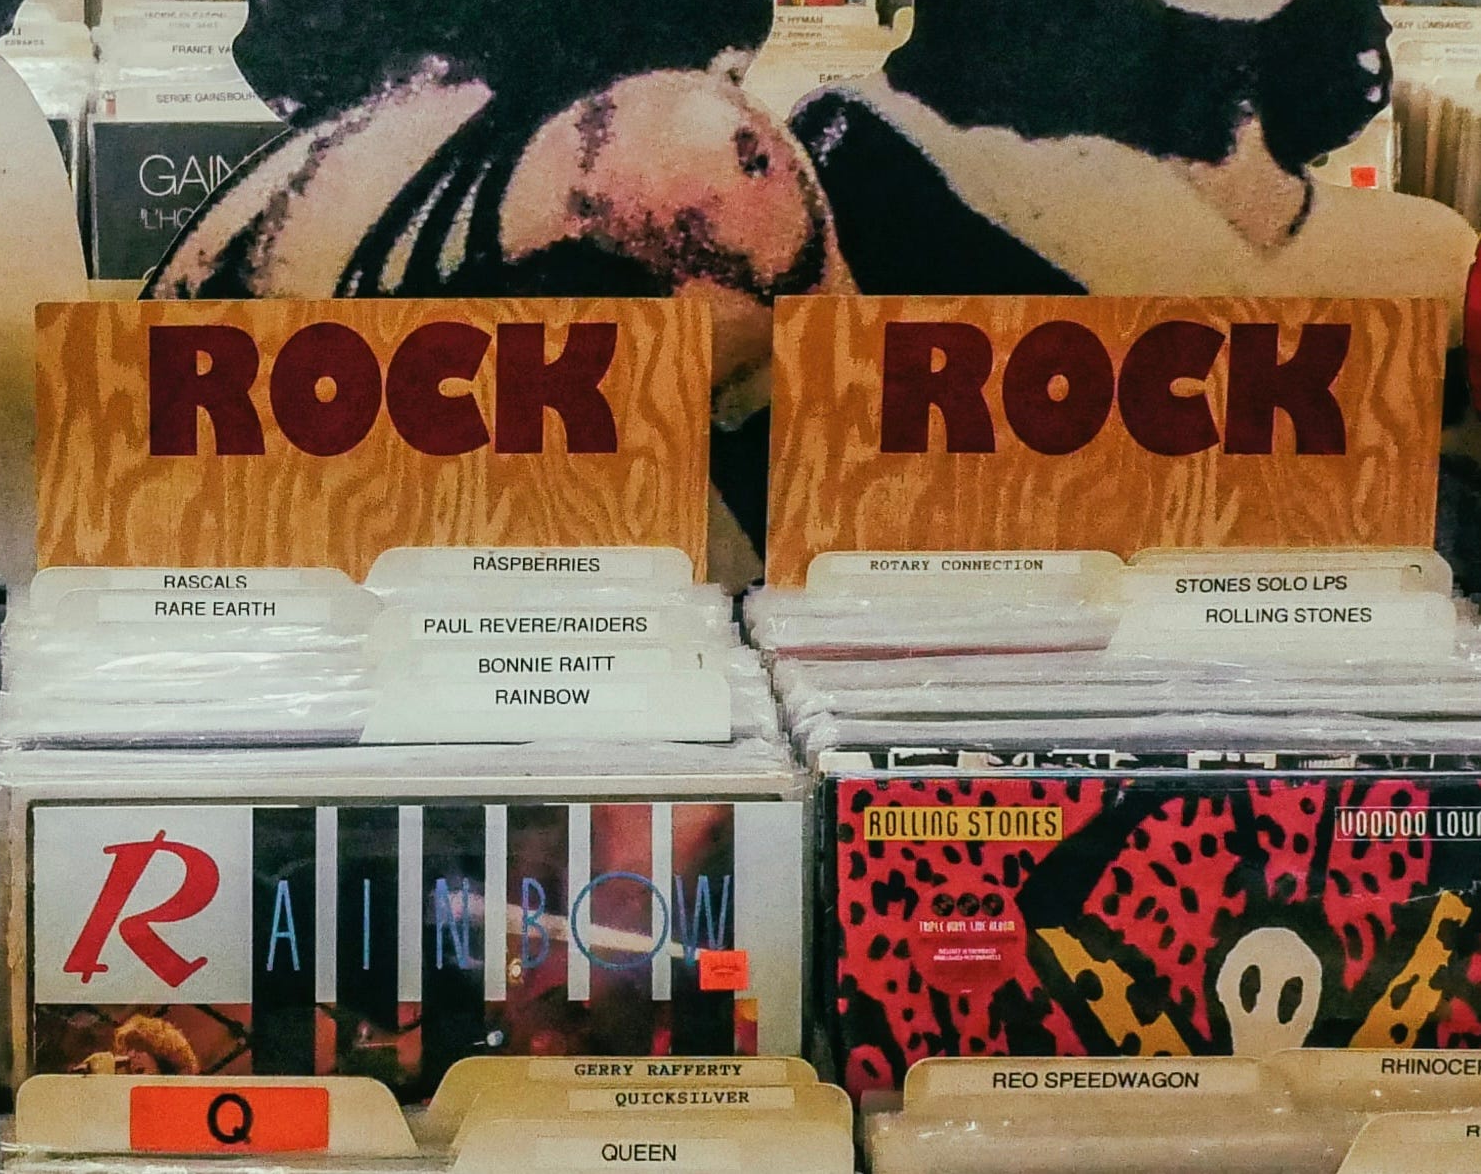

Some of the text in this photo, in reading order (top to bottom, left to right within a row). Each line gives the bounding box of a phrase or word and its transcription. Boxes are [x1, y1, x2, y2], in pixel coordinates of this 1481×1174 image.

[172, 45, 213, 54] FRANCE
[156, 93, 191, 103] SERGE
[152, 321, 618, 457] ROCK
[880, 320, 1351, 455] ROCK
[473, 556, 600, 572] RASPBERRIES
[870, 560, 1043, 570] ROTARY CONNECTION
[164, 575, 247, 588] RASCALS
[1175, 576, 1348, 593] STONES SOLO LPS
[155, 602, 276, 616] RARE EARTH
[1206, 607, 1372, 624] ROLLING STONES
[424, 617, 648, 634] PAUL REVERE/RAIDERS
[479, 656, 615, 673] BONNIE RAITT
[495, 689, 590, 704] RAINBOW
[869, 811, 1057, 837] ROLLING STONES
[1341, 811, 1427, 837] VOODOO
[63, 829, 732, 988] RAINBOW
[574, 1064, 743, 1076] GERRY RAFFERTY
[1382, 1058, 1481, 1075] RHINOCE
[993, 1072, 1199, 1088] REO SPEEDWAGON
[615, 1092, 750, 1107] QUICKSILVER
[208, 1093, 253, 1145] Q
[601, 1143, 677, 1161] QUEEN
